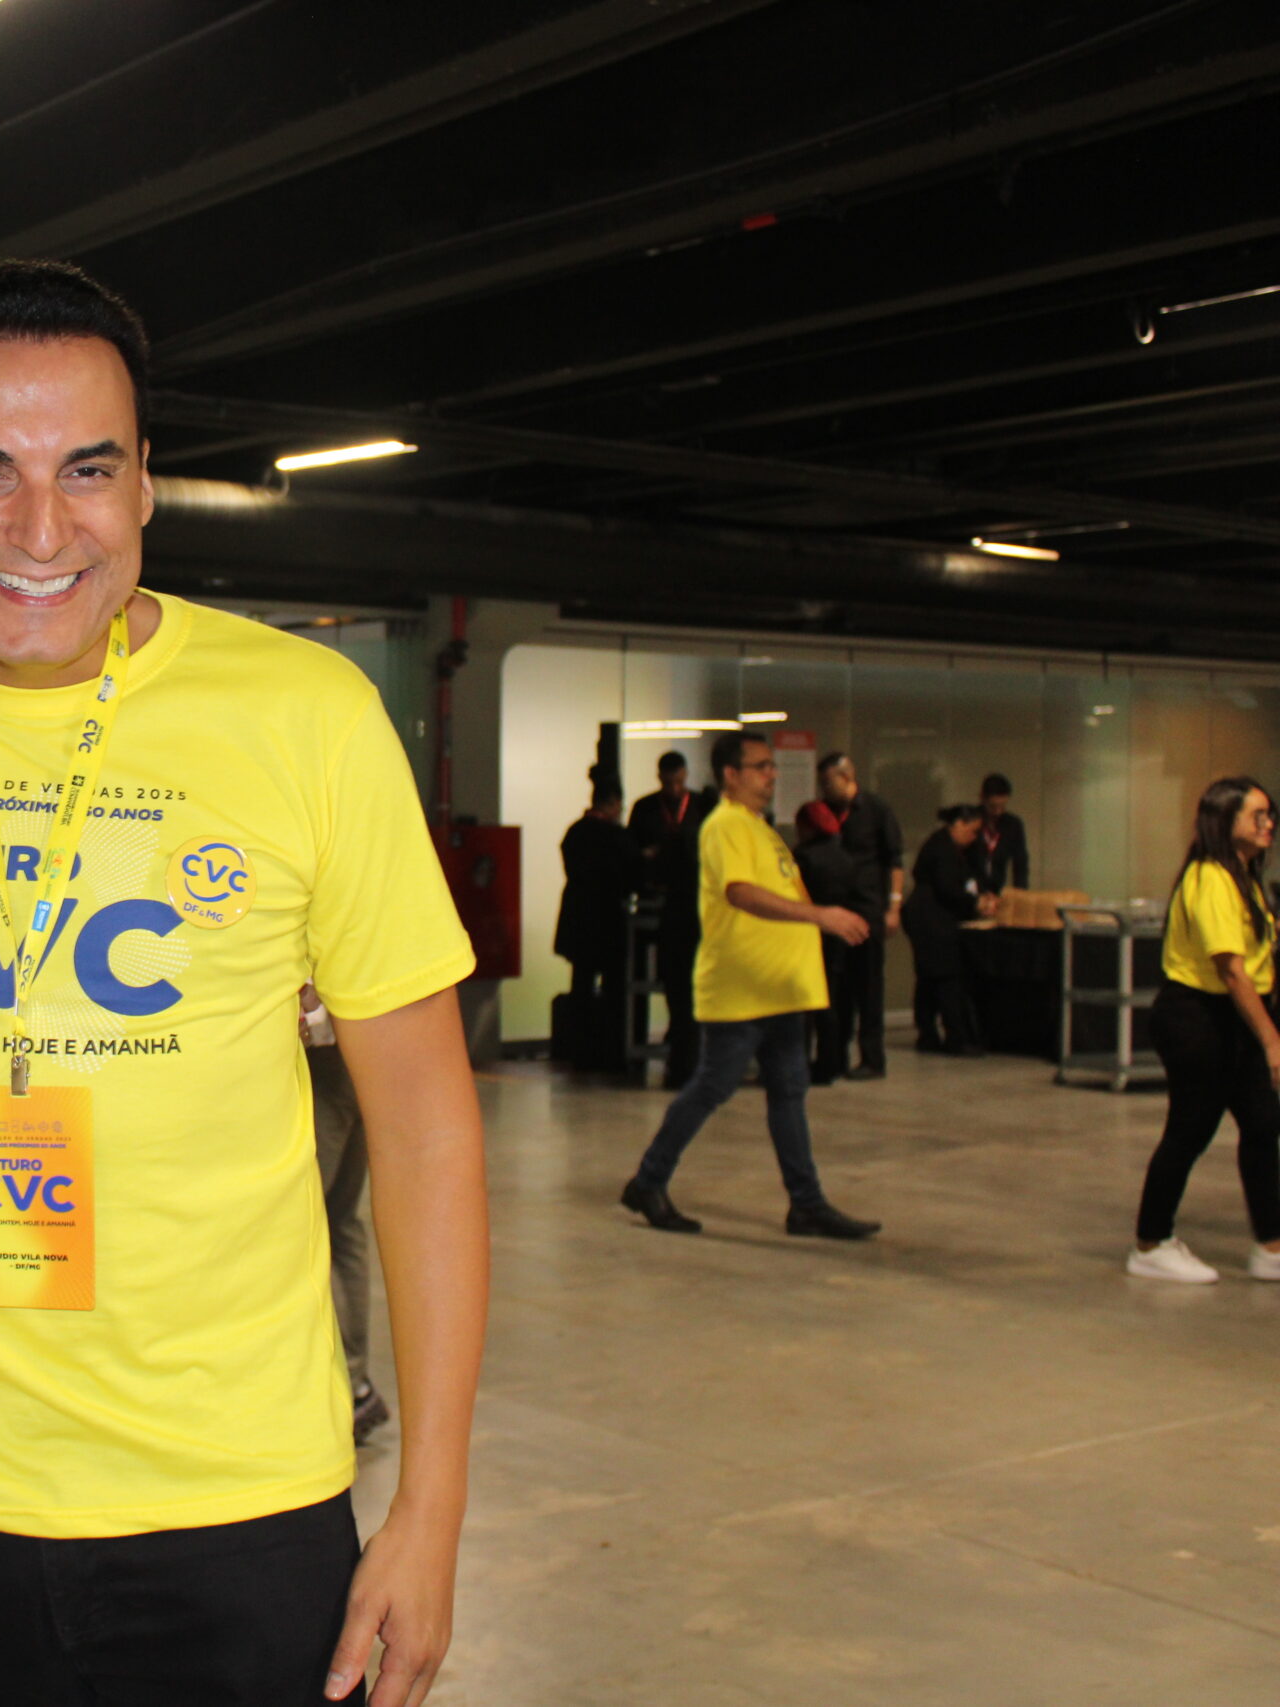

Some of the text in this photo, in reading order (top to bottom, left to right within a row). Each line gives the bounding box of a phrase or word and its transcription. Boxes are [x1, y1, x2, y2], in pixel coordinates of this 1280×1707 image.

[78, 719, 98, 753] CVC
[4, 780, 187, 800] DE VEAS 2025
[109, 808, 164, 821] ANOS
[182, 854, 248, 893] CVC
[2, 1037, 59, 1054] HOJE
[65, 1040, 77, 1054] E
[83, 1034, 181, 1055] AMANHÃ
[44, 1254, 69, 1262] NOVA
